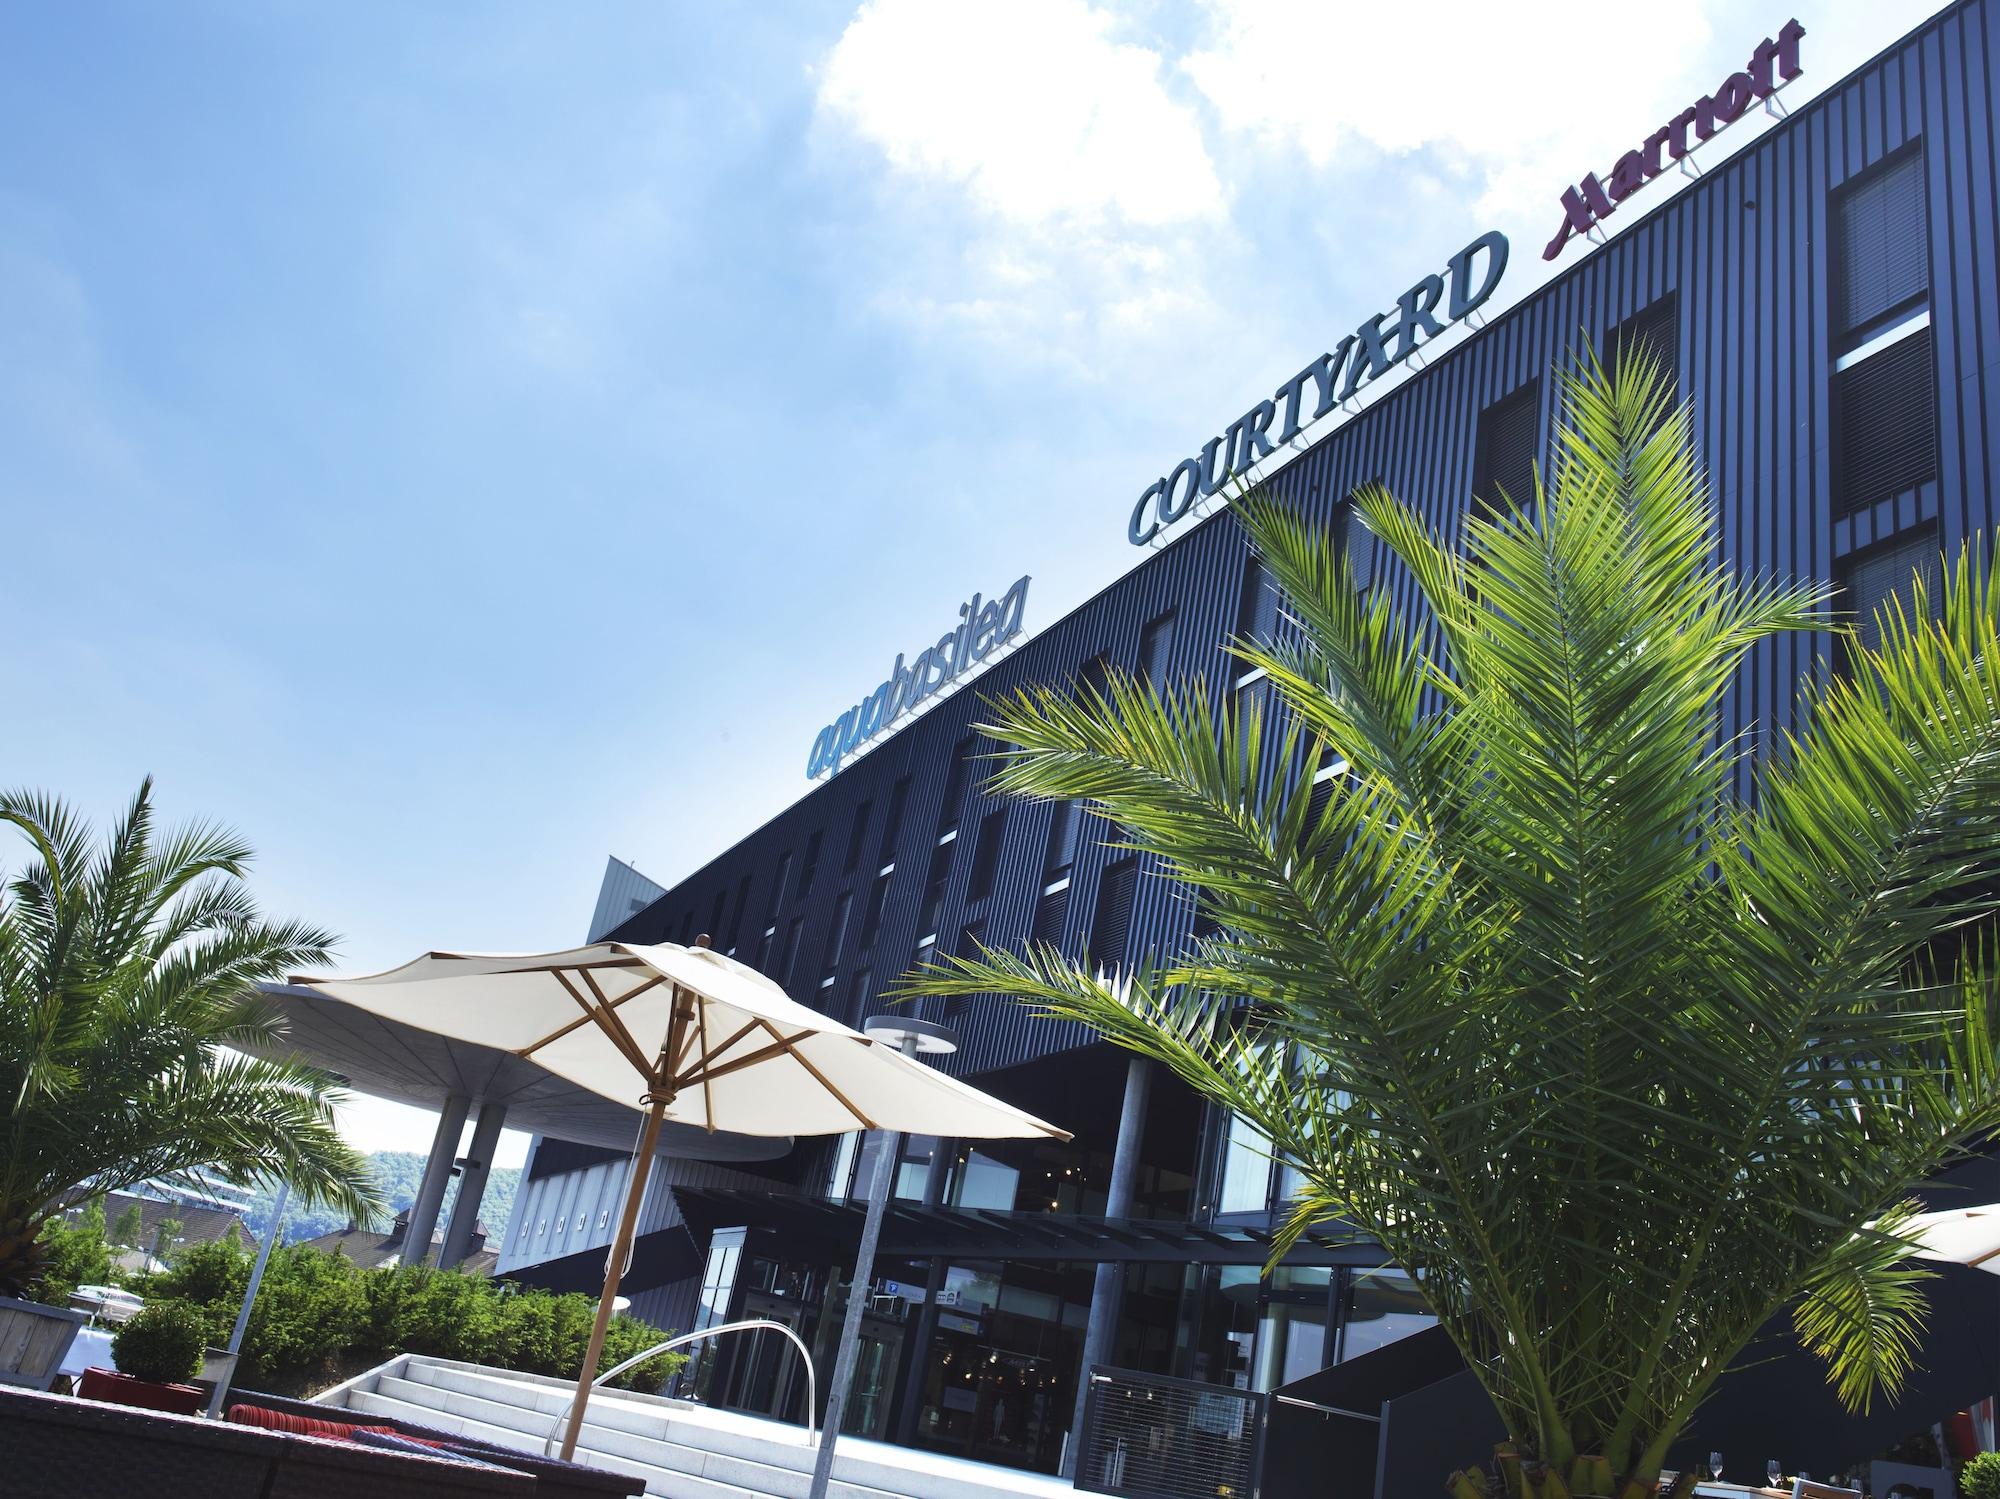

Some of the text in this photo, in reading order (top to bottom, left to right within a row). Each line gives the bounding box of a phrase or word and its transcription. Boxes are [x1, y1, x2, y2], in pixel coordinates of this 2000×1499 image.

[1542, 18, 1806, 261] Marriott
[1128, 230, 1510, 546] COURTYARD
[806, 575, 1032, 780] aquabasilea
